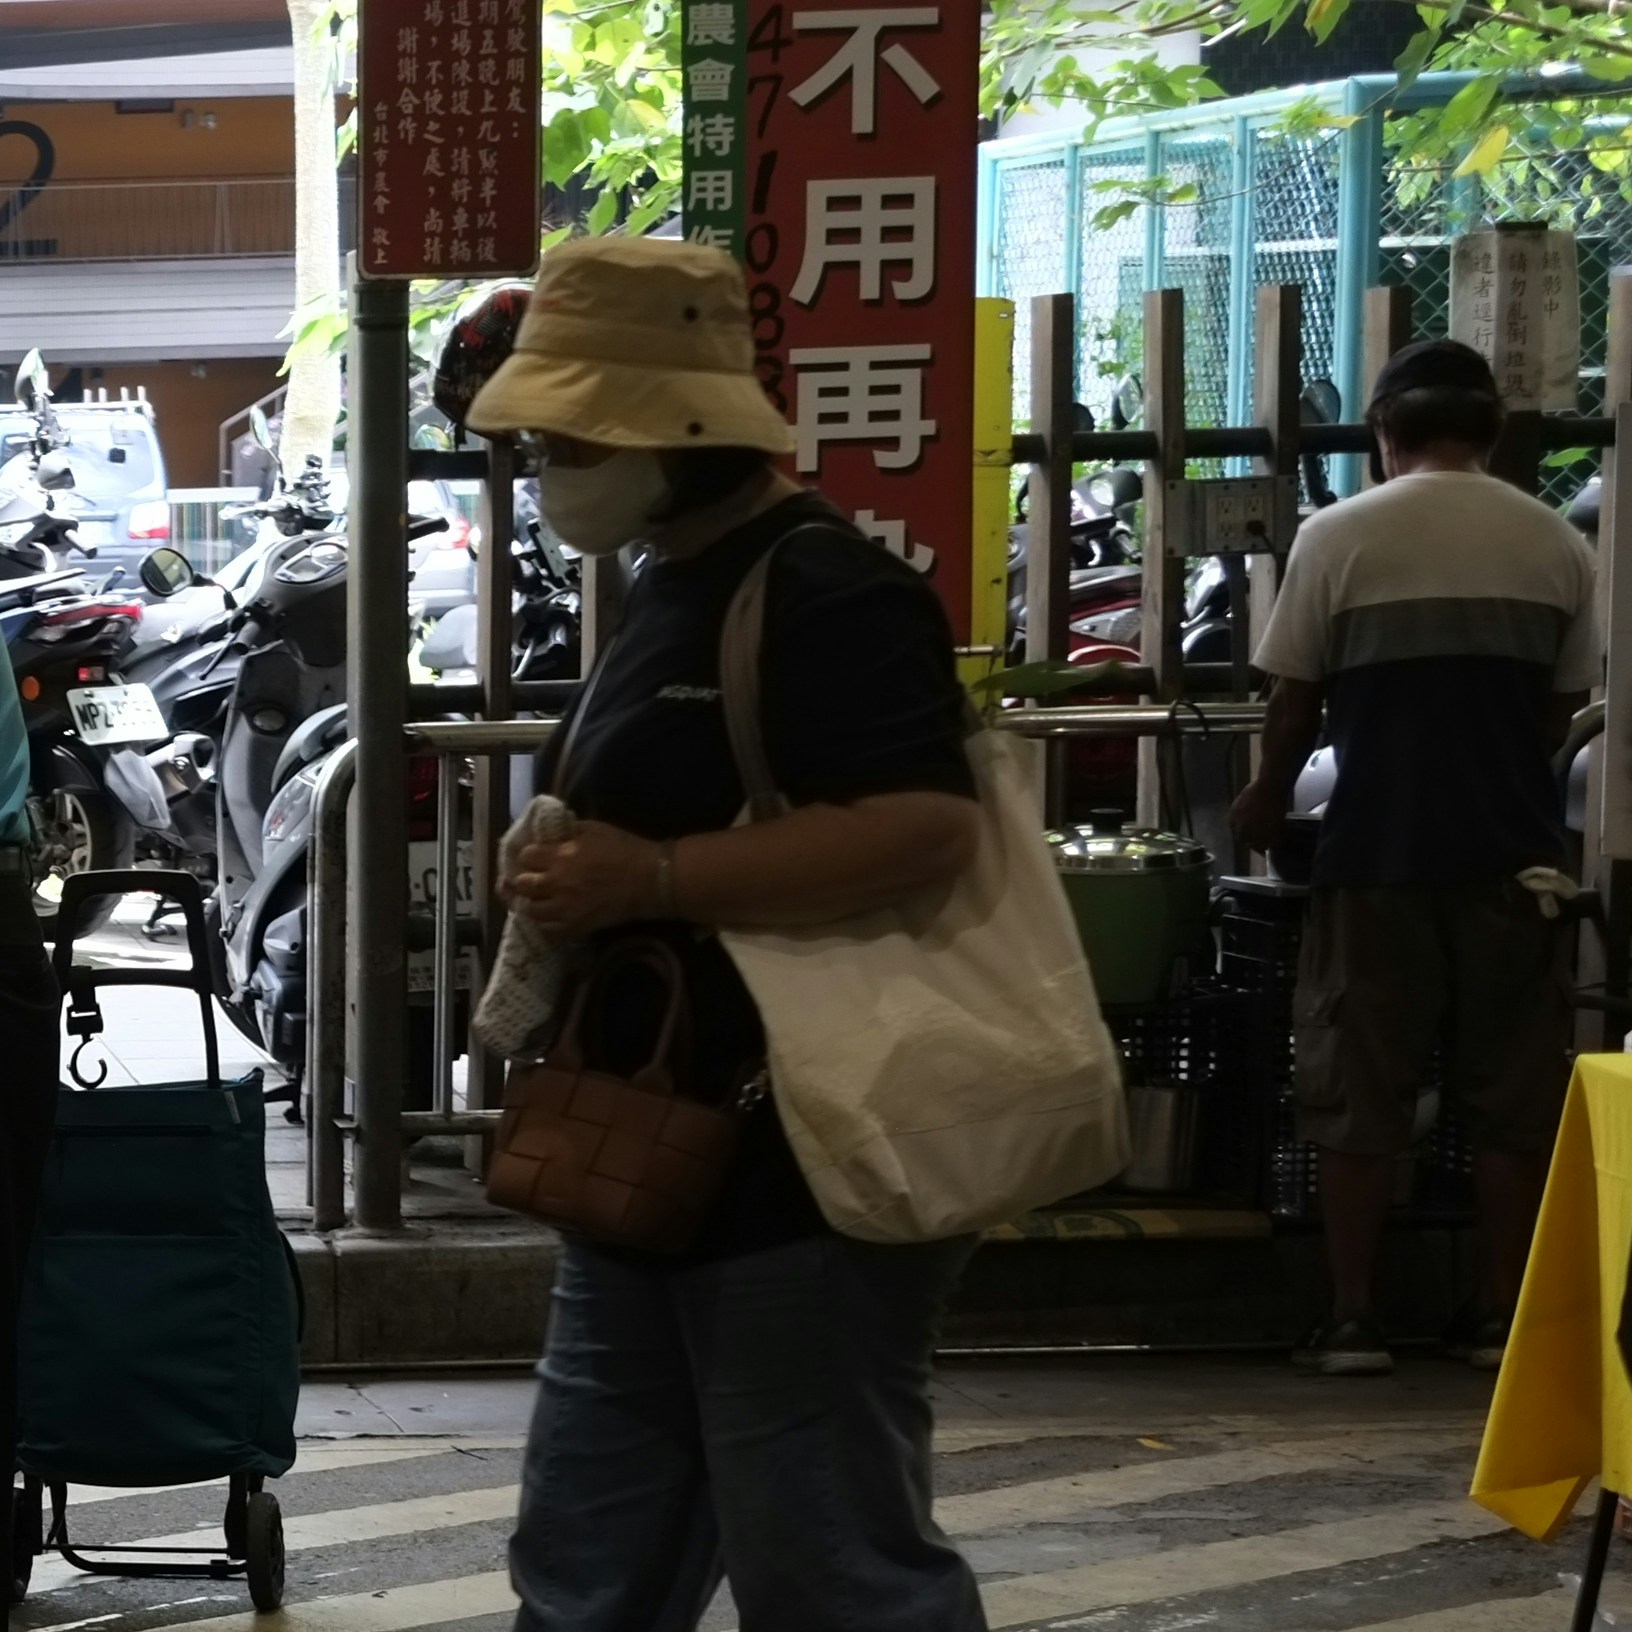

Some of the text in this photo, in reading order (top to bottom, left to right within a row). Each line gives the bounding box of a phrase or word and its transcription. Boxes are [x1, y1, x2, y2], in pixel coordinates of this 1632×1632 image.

[397, 26, 421, 146] 謝謝合作
[373, 101, 391, 215] 台北市農會
